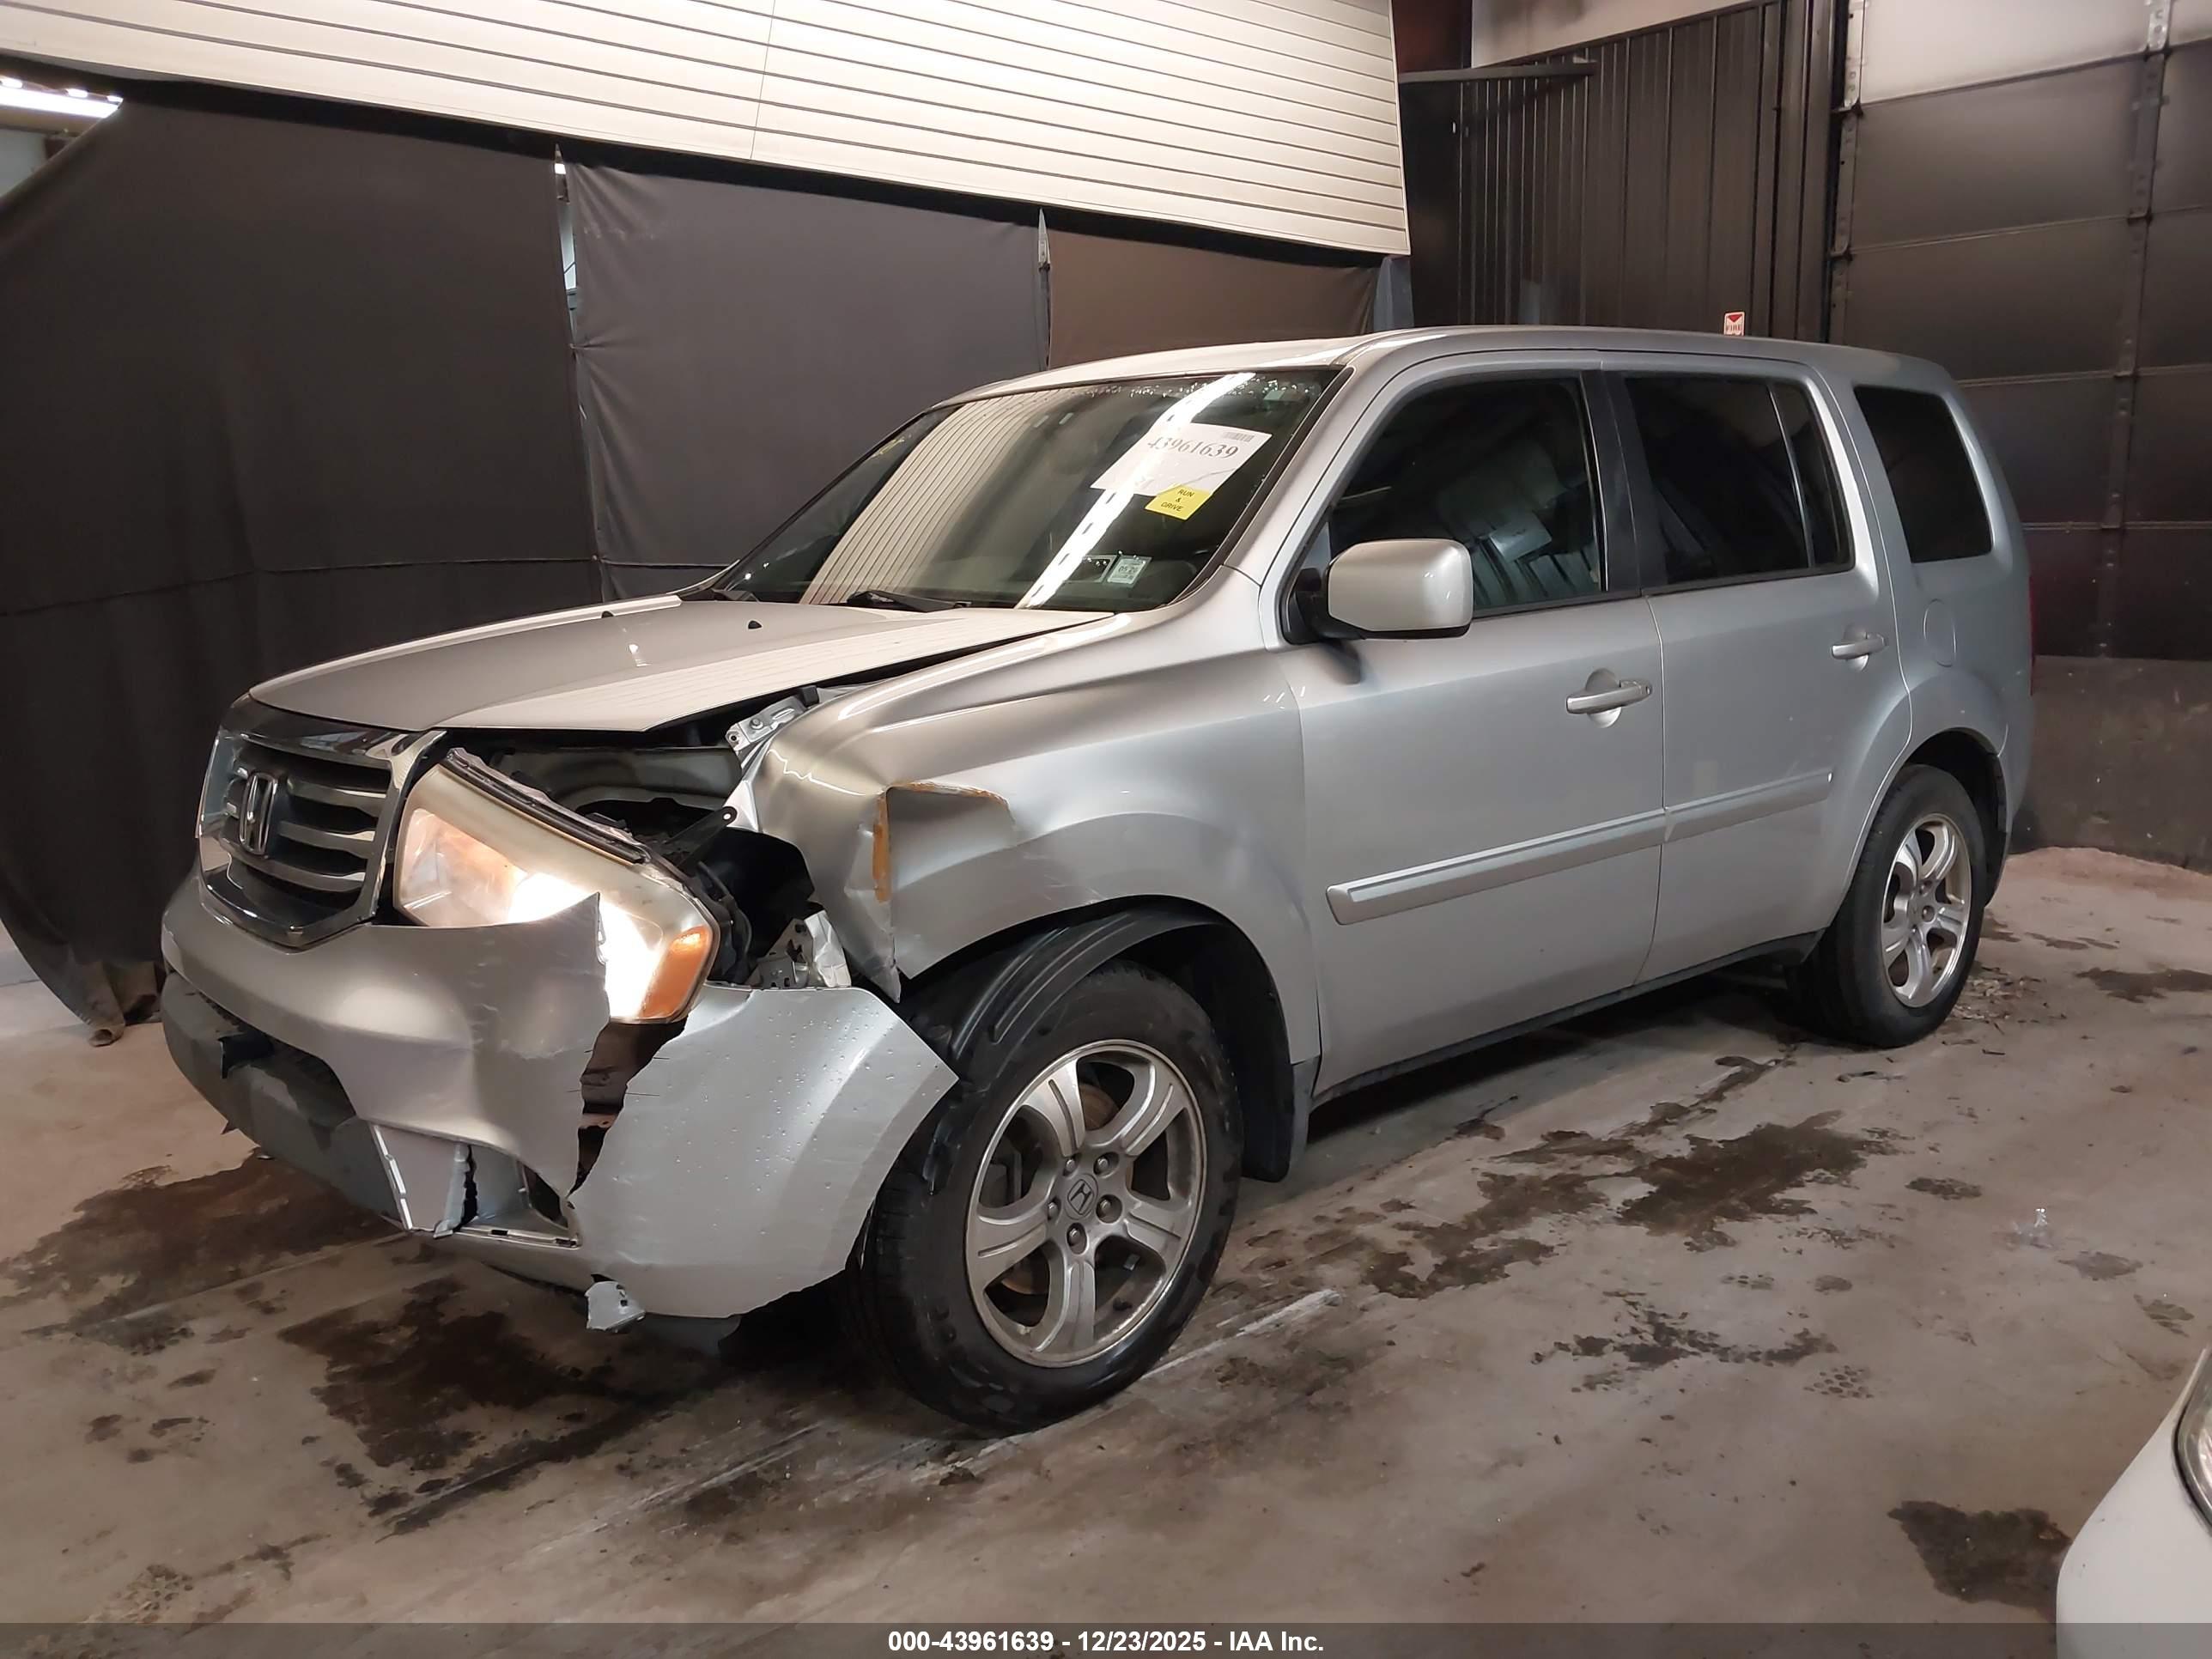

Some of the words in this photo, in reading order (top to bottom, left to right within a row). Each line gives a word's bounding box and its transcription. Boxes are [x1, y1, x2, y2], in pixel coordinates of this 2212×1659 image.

[1148, 436, 1238, 458] 43961639
[1177, 489, 1195, 497] RUN
[1161, 501, 1183, 511] DRIVE
